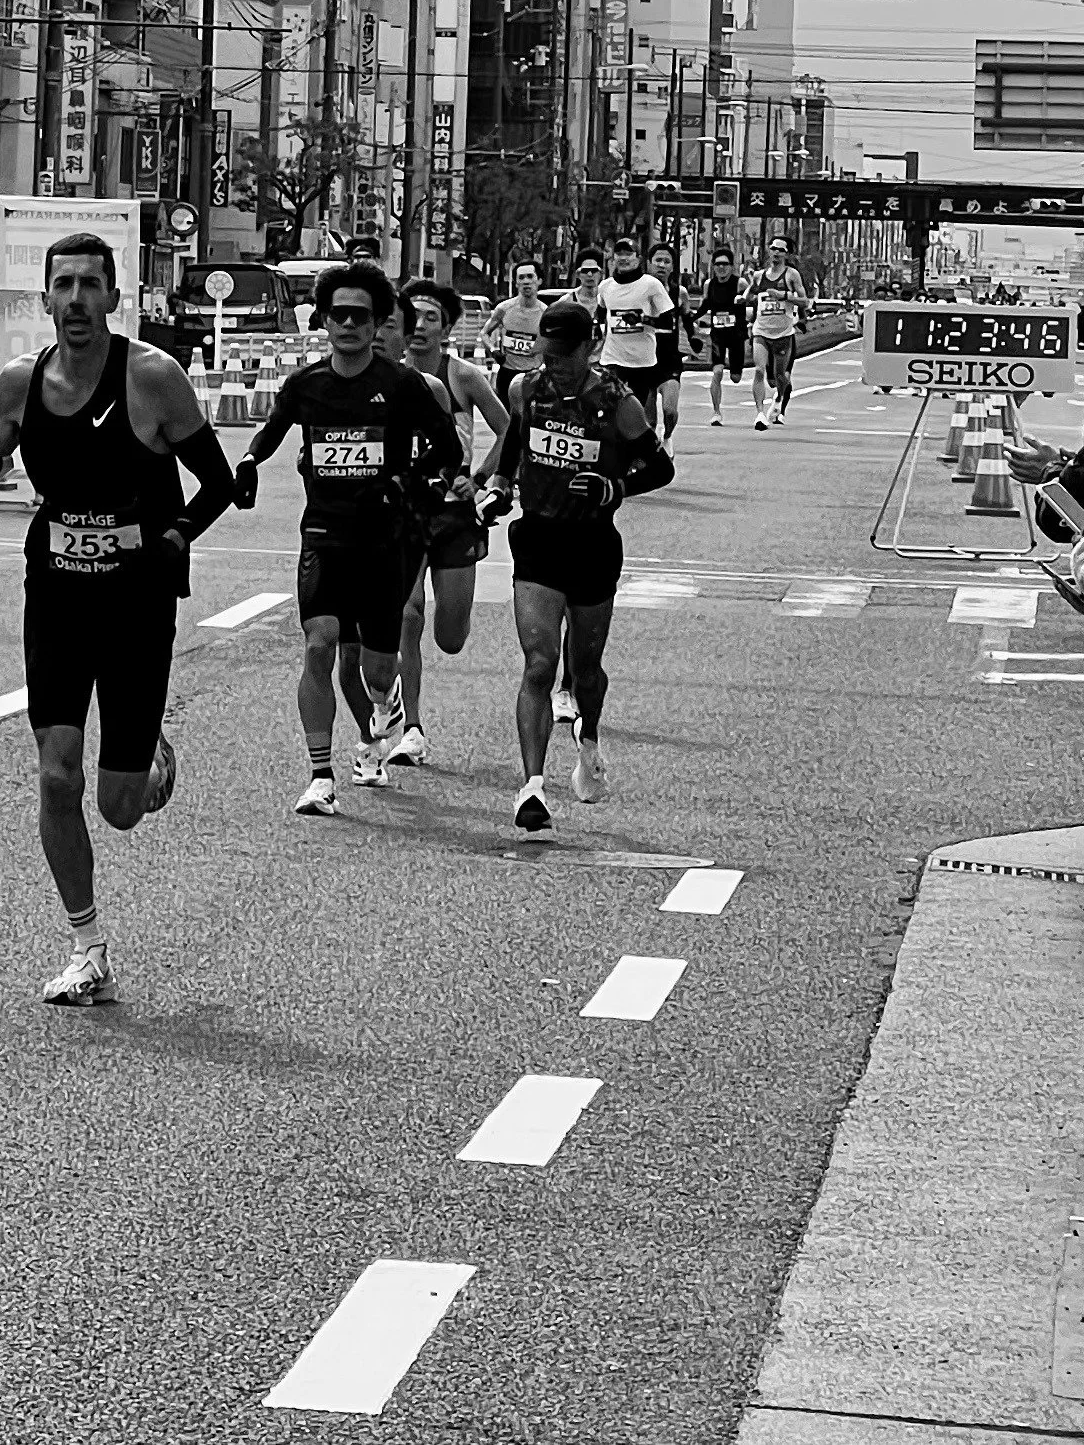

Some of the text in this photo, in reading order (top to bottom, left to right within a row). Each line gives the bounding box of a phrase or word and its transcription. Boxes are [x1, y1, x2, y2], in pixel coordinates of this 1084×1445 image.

[141, 135, 153, 170] YKK
[211, 155, 228, 206] AXIS
[907, 359, 1035, 388] SEIKO
[324, 446, 370, 465] 274
[541, 435, 585, 460] 193
[347, 467, 379, 477] Metro
[61, 511, 117, 527] OPTAGE
[63, 532, 120, 557] 253
